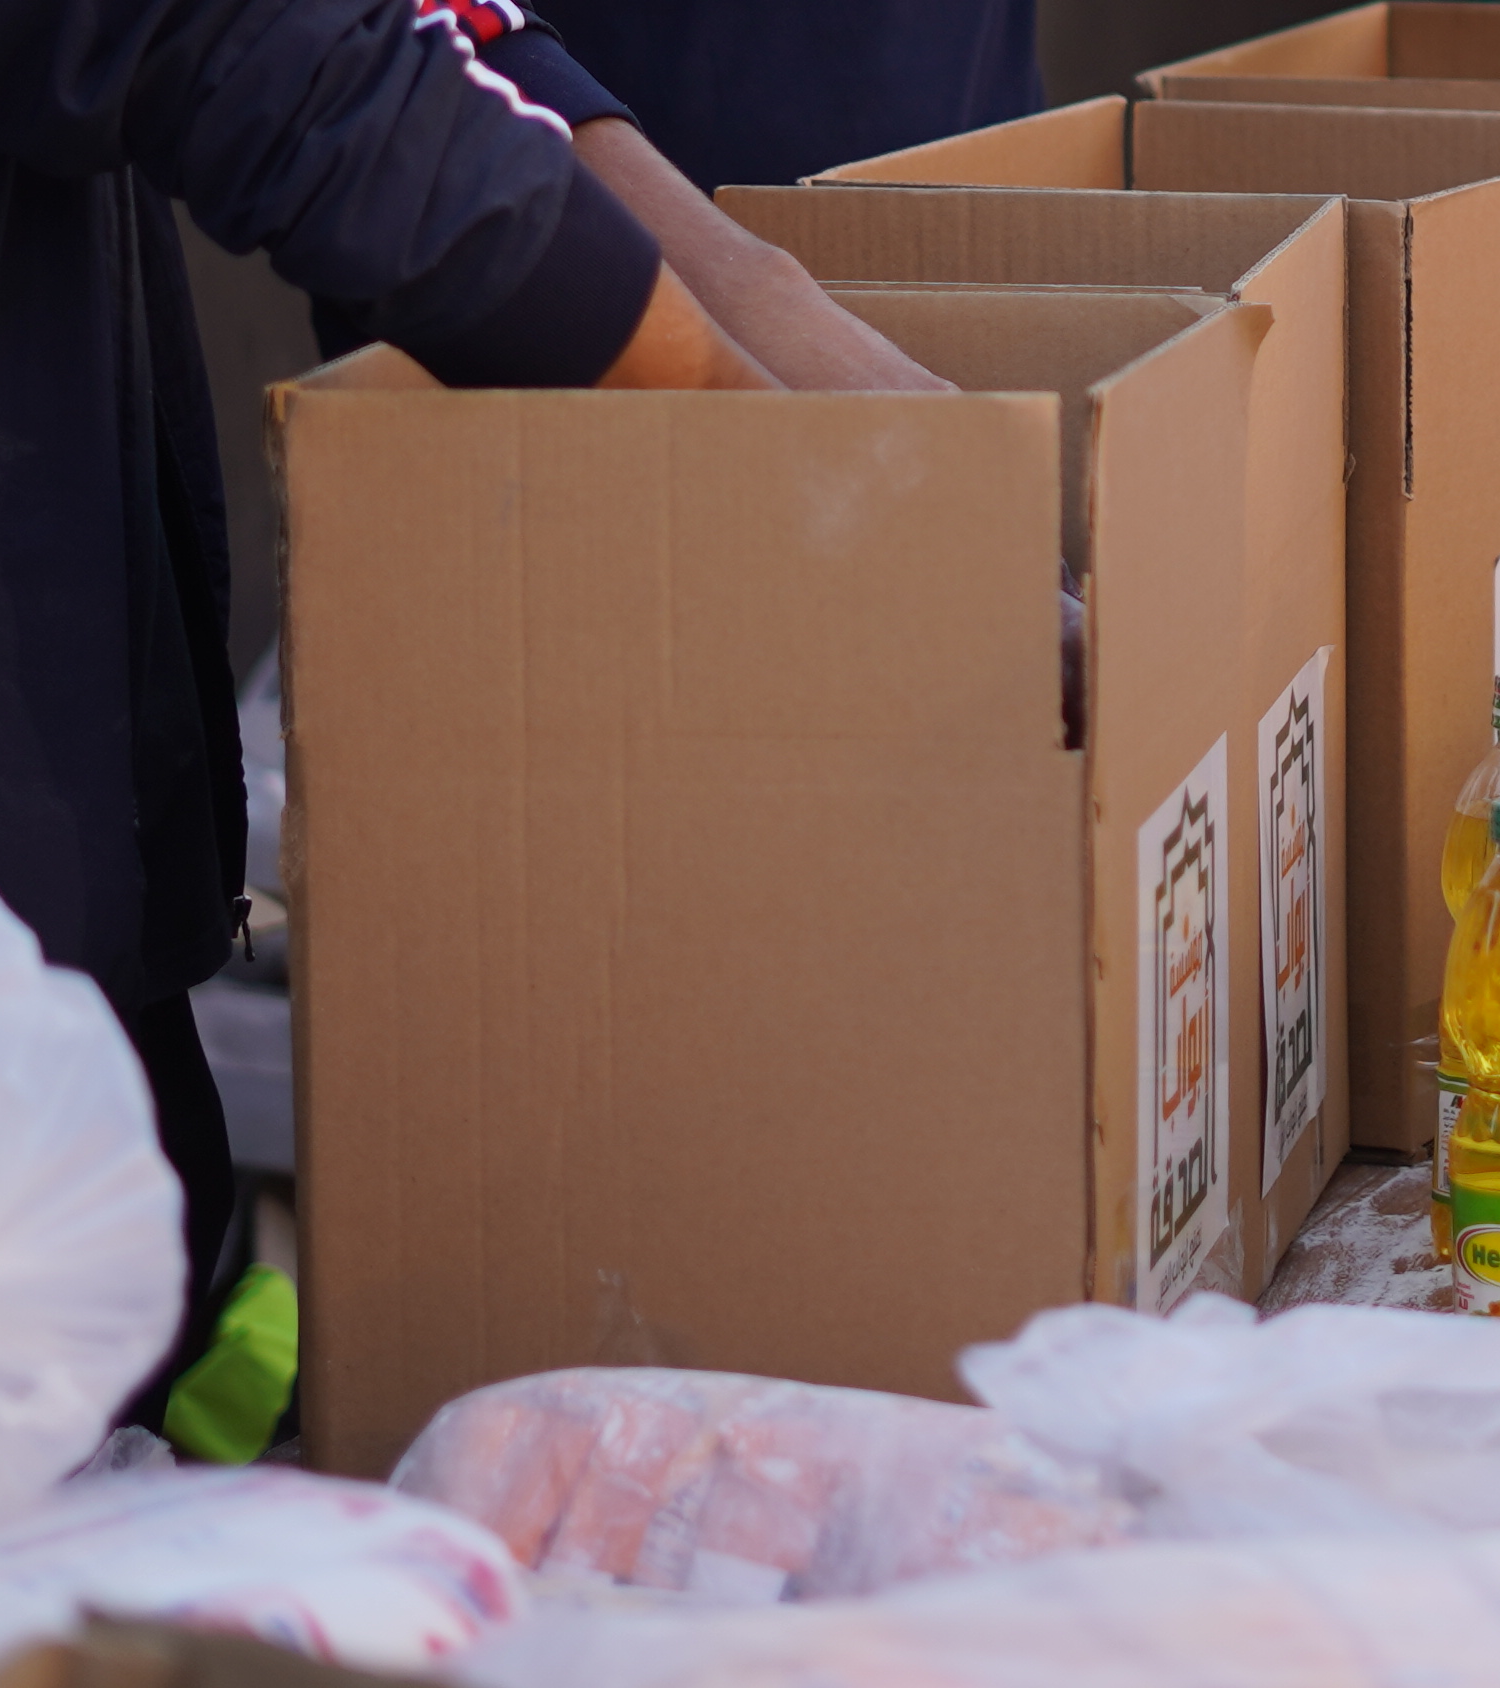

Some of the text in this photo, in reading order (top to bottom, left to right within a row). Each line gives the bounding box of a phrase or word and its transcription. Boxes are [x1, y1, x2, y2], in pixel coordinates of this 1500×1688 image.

[1169, 924, 1203, 999] مؤسسة
[1161, 978, 1210, 1133] أبواب
[1149, 1096, 1208, 1273] الصدقة
